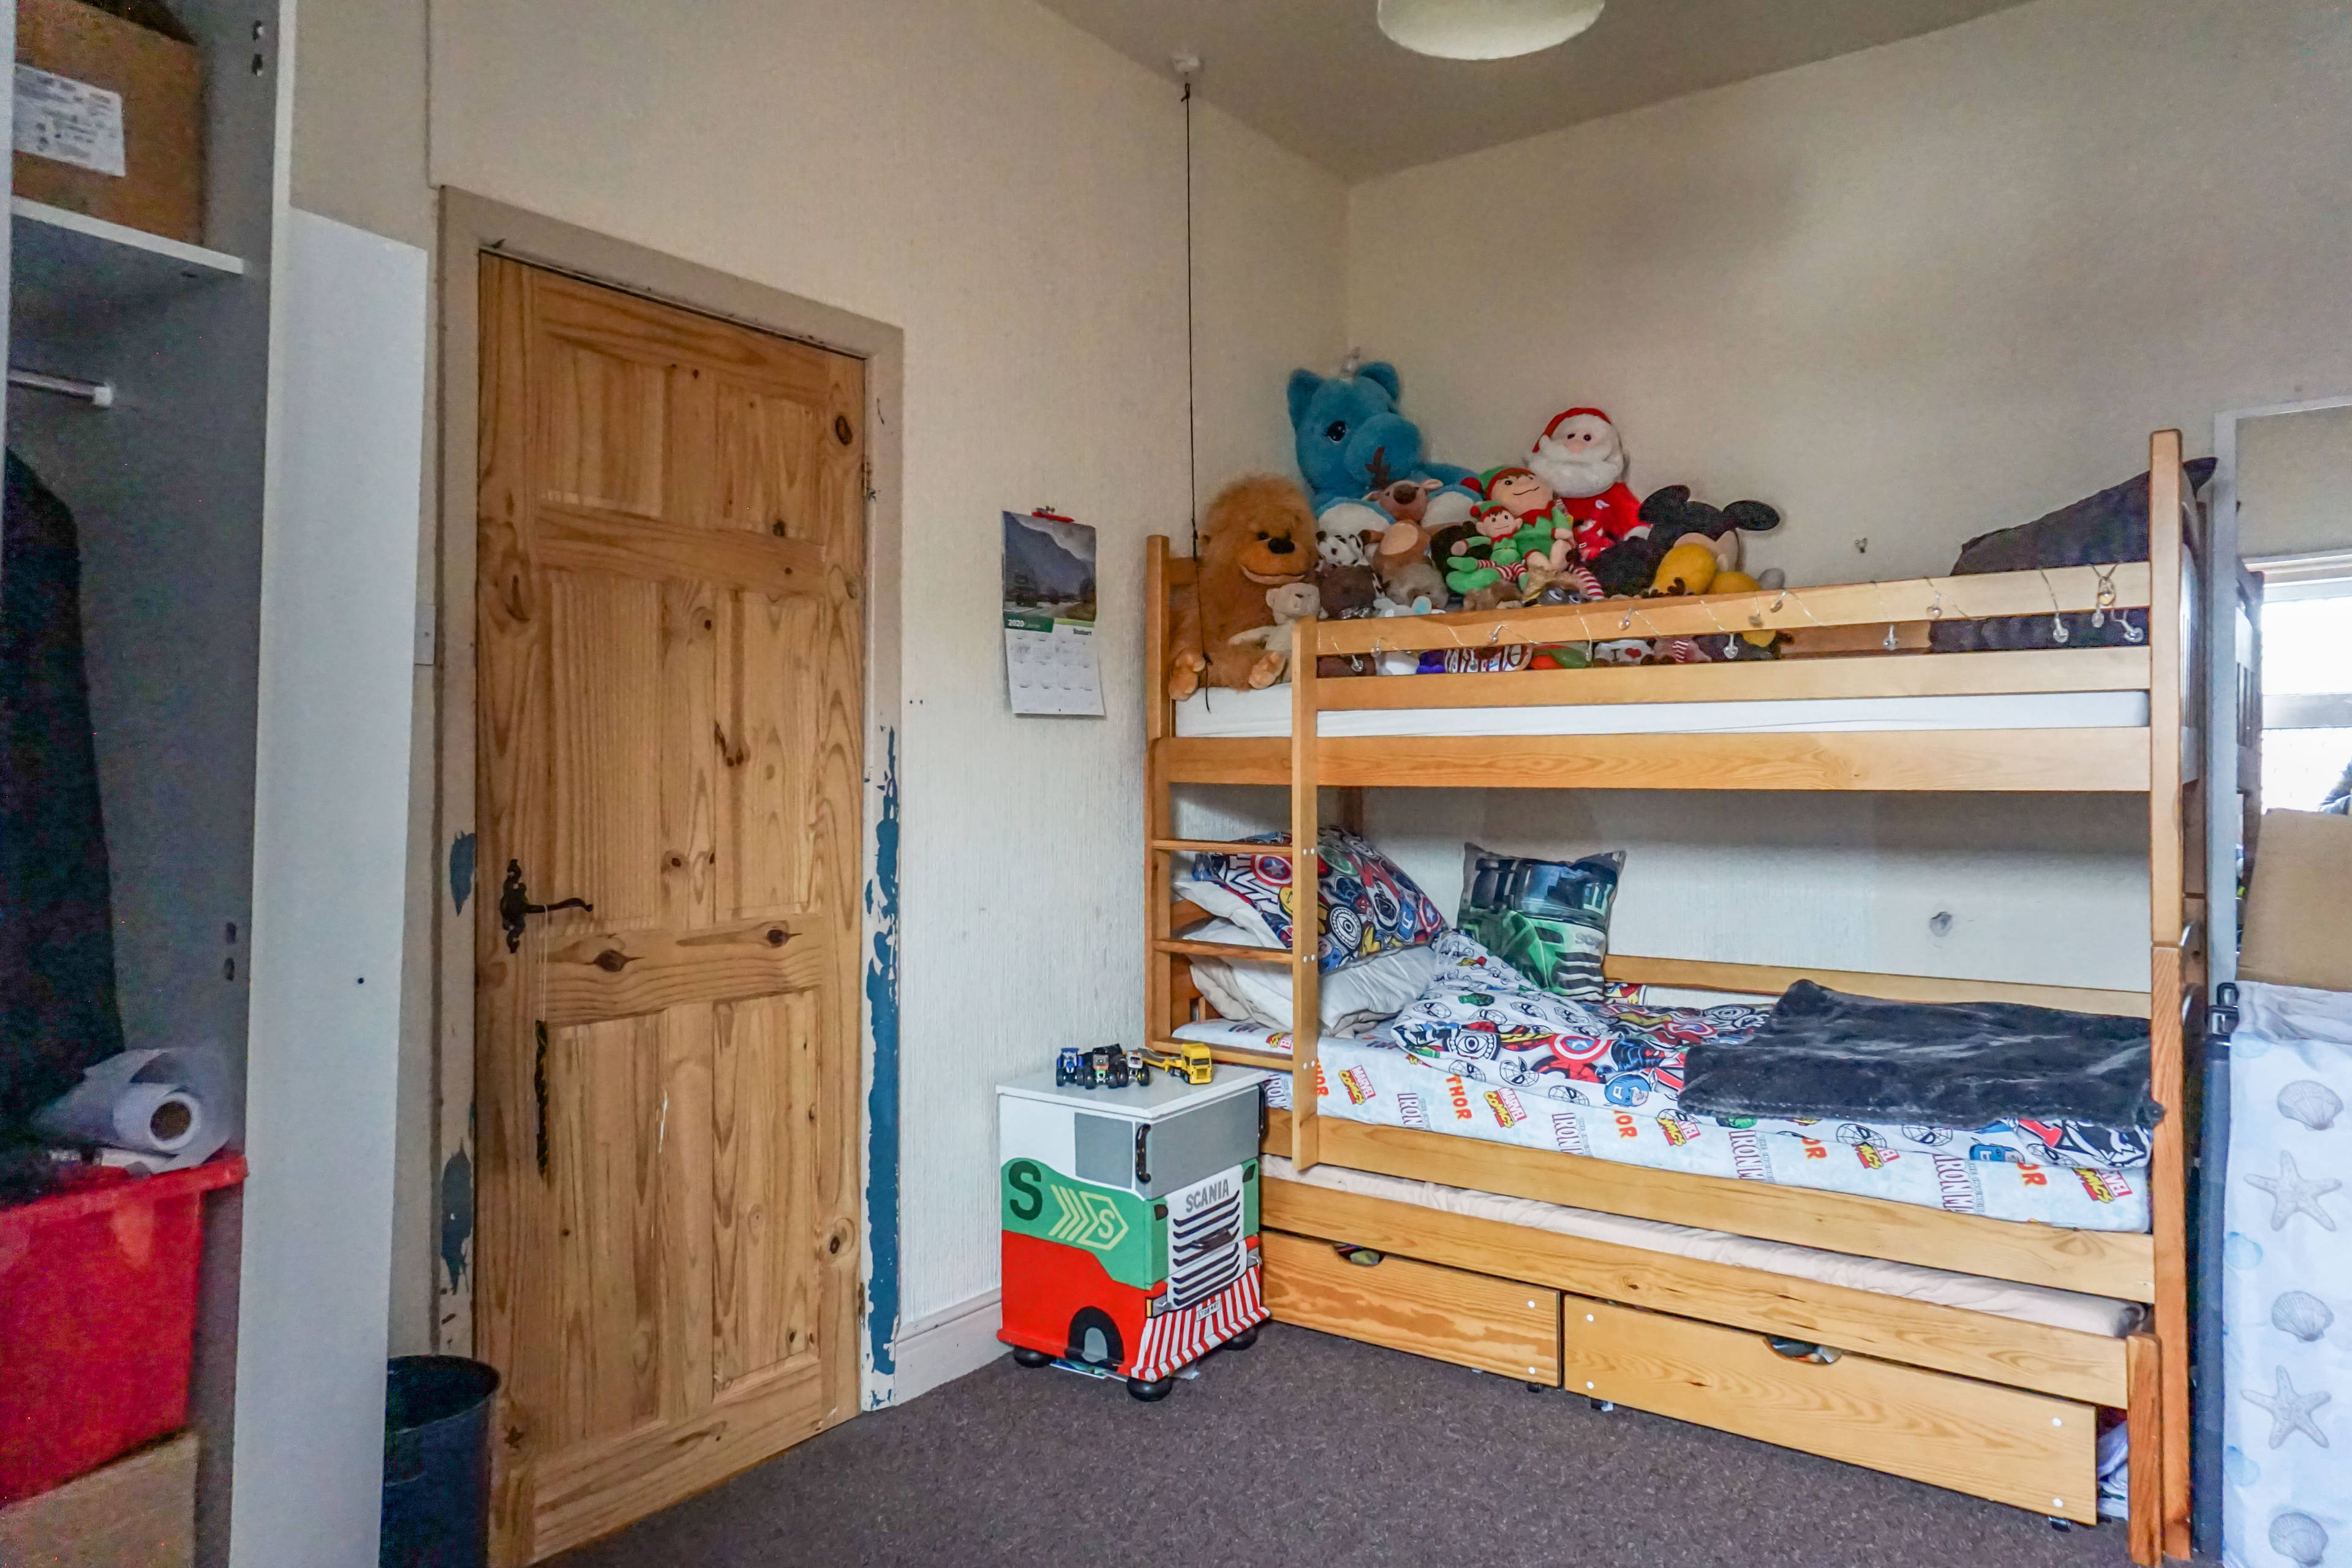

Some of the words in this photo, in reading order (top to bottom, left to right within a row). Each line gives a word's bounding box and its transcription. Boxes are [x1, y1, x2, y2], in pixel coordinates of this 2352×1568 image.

[1338, 1070, 1366, 1105] COMICS
[1350, 1065, 1376, 1099] MARVEL
[1446, 1074, 1472, 1120] THOR
[1397, 1092, 1423, 1125] IRON
[1484, 1091, 1515, 1128] COMICS
[1499, 1087, 1526, 1121] MARVEL
[1551, 1112, 1585, 1147] IRON
[1614, 1110, 1638, 1139] OR
[1728, 1129, 1764, 1167] IRON
[1009, 1161, 1042, 1220] S
[1932, 1154, 1972, 1194] IRON
[1185, 1178, 1229, 1213] SCANIA
[1097, 1209, 1115, 1238] S
